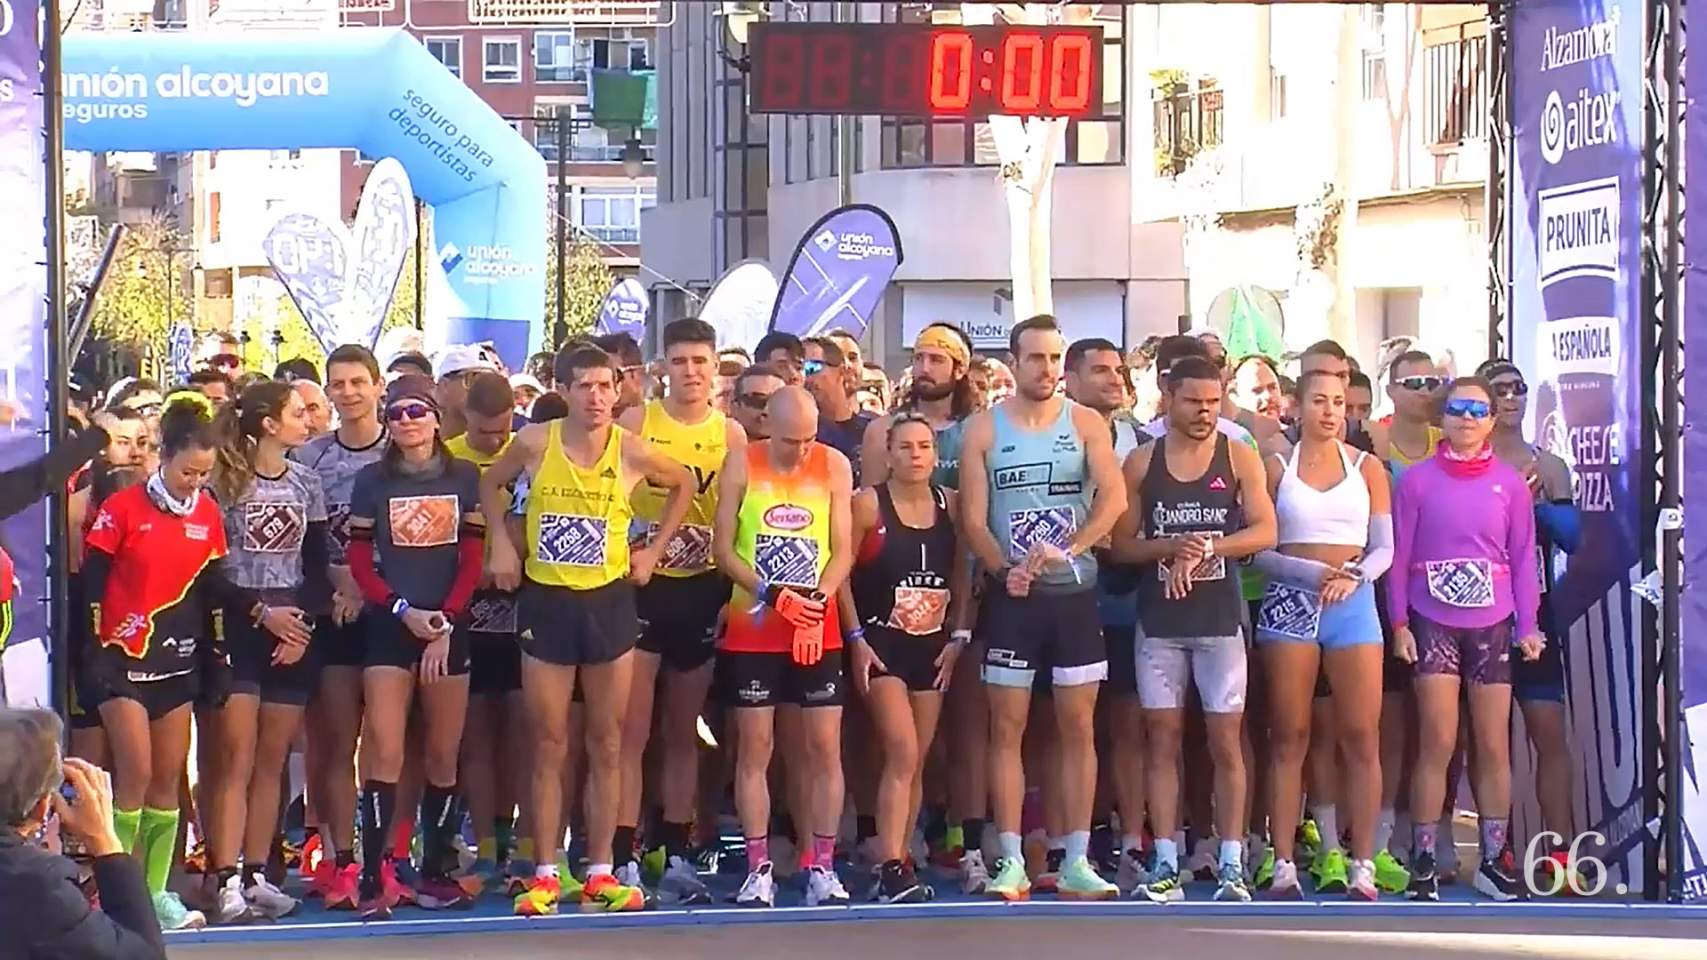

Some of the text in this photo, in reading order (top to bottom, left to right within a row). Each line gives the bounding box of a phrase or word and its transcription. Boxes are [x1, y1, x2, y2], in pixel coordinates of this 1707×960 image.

[1540, 20, 1617, 71] Alzamora
[155, 64, 329, 107] alcoyana
[930, 32, 1092, 110] 0:00
[64, 103, 148, 124] eguros
[403, 89, 494, 168] seguro para
[1566, 87, 1618, 151] aitex
[388, 107, 477, 182] deportistas
[1546, 206, 1611, 252] PRUNITA
[1559, 323, 1612, 362] ESPAÑOLA
[998, 471, 1027, 485] BAE
[262, 516, 285, 539] 679
[553, 526, 582, 553] 2258
[767, 545, 796, 573] 2213
[1270, 598, 1297, 622] 2215
